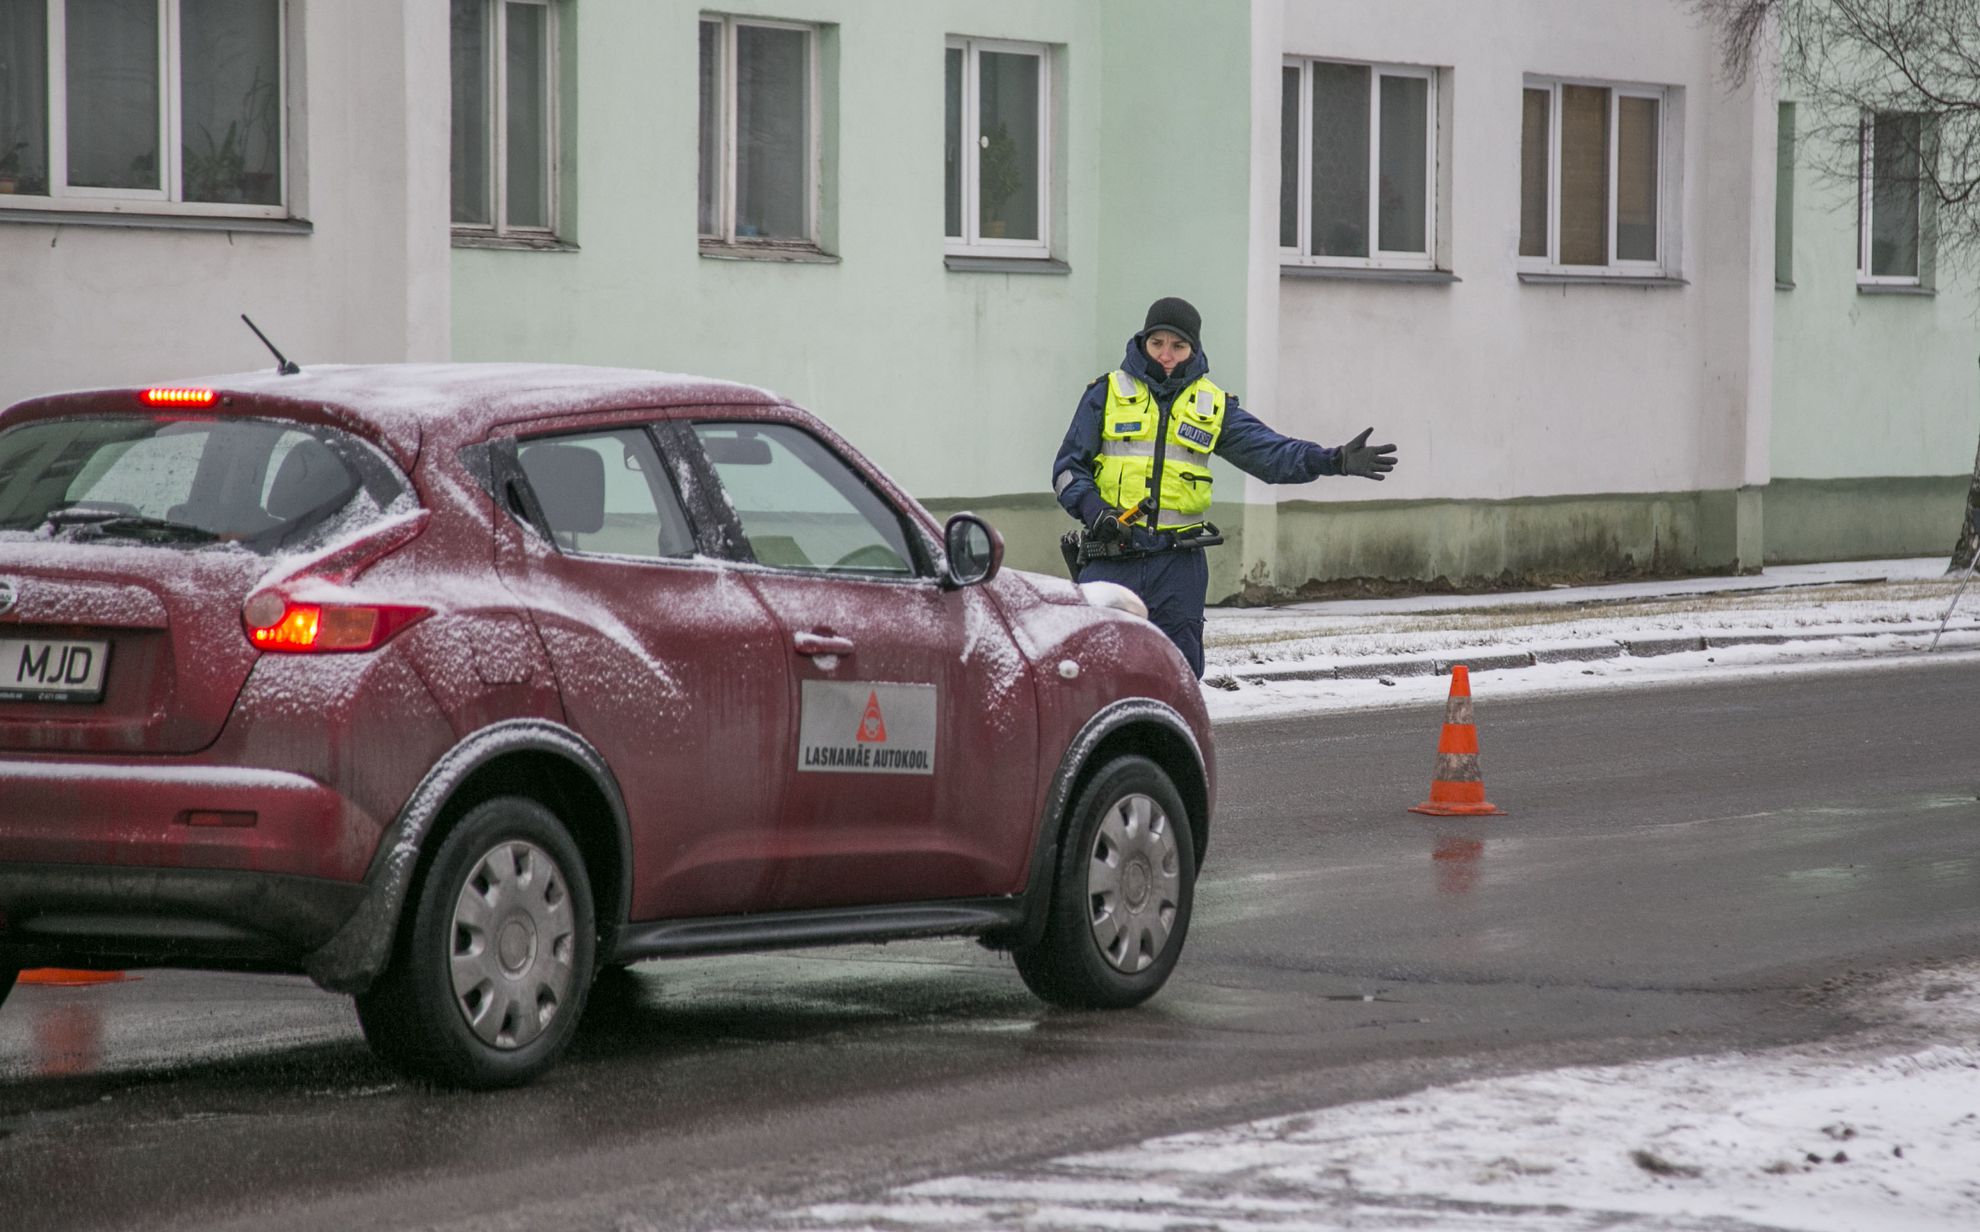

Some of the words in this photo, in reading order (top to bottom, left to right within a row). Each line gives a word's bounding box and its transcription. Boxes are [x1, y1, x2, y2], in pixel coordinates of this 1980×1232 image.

[16, 644, 93, 684] MJD
[804, 743, 871, 767] LASNAMÄE
[872, 748, 929, 770] AUTOKOOL
